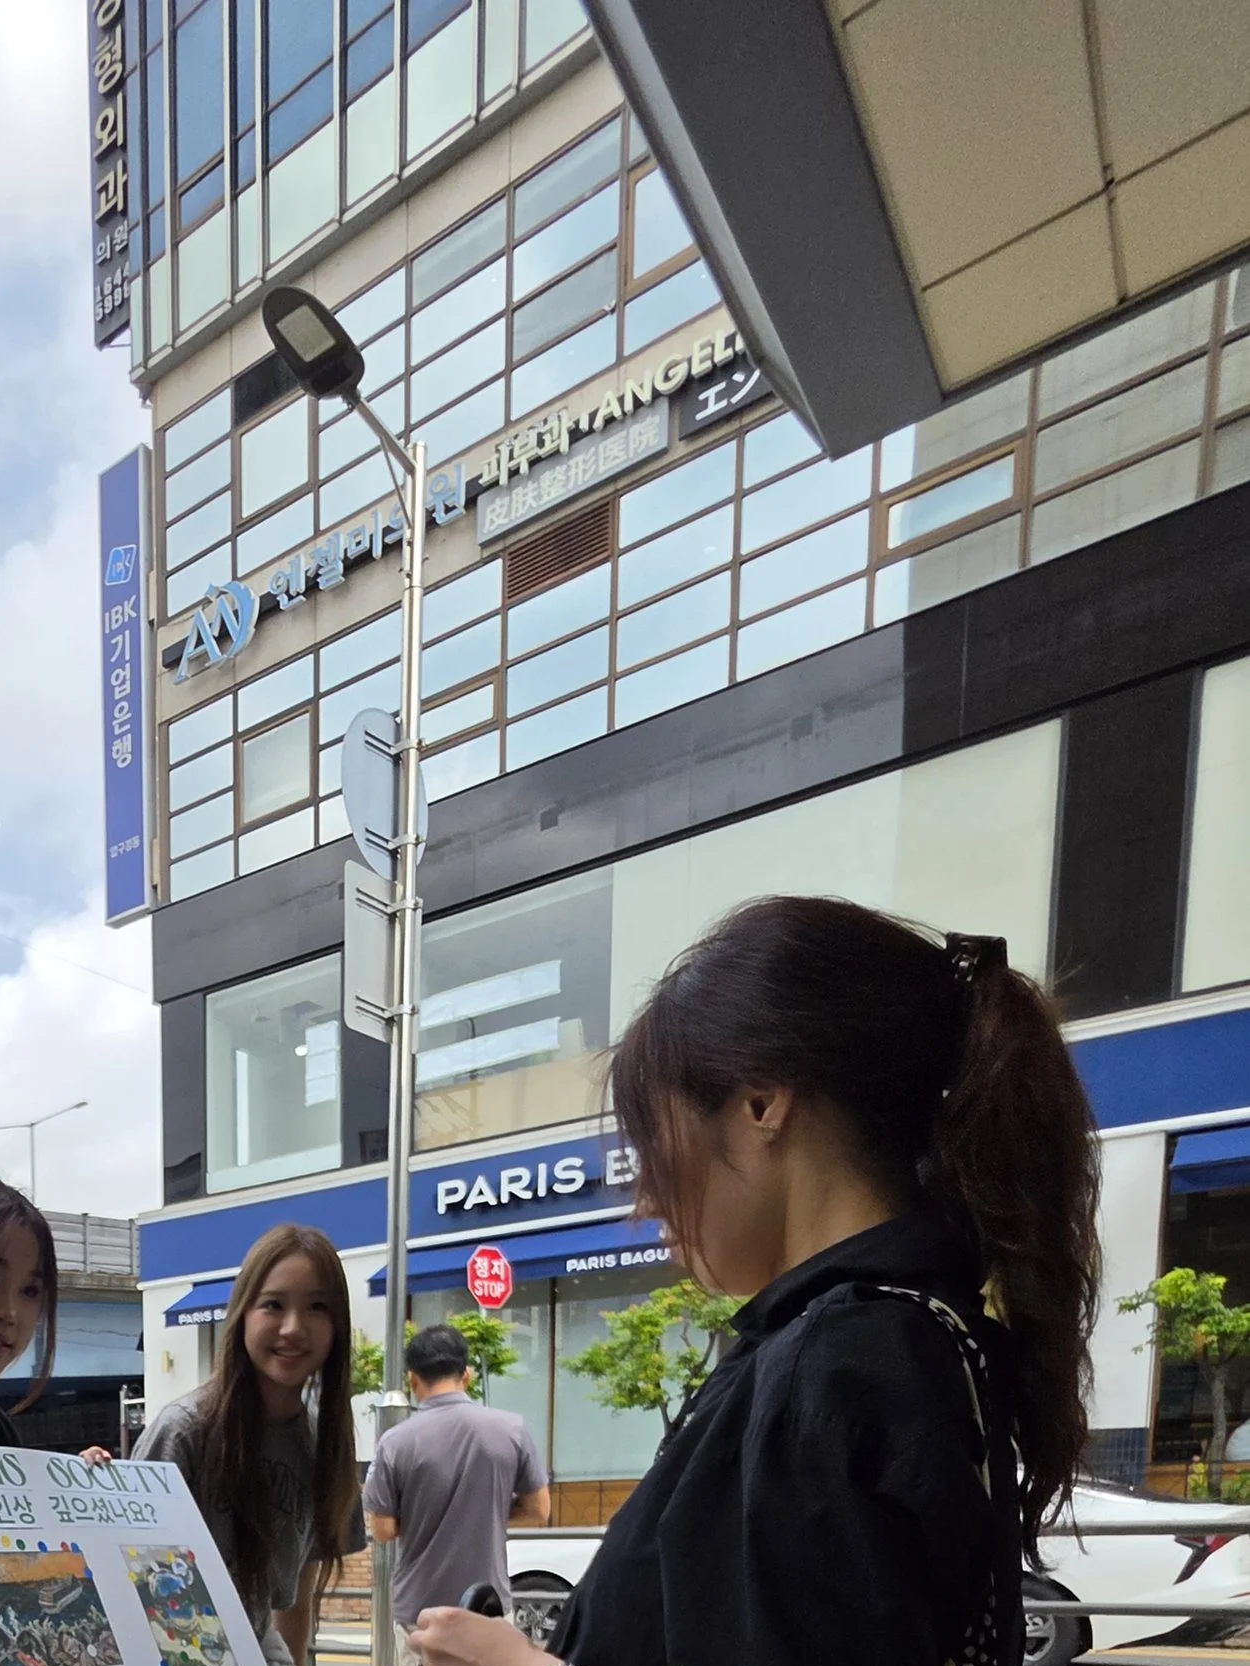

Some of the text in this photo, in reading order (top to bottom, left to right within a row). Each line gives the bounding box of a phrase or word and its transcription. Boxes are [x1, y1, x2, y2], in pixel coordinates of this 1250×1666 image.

[95, 220, 129, 265] 의원
[478, 405, 575, 487] 피부과
[482, 415, 662, 534] 皮肤整形医院
[104, 594, 138, 635] IBK
[110, 629, 133, 769] 기업은행
[436, 1156, 587, 1216] PARIS
[473, 1256, 505, 1280] 정지
[565, 1253, 617, 1273] PARIS
[473, 1280, 506, 1299] STOP
[178, 1310, 213, 1325] PARIS
[46, 1456, 173, 1495] SOCIETY
[48, 1494, 159, 1525] 깊으셨나요?
